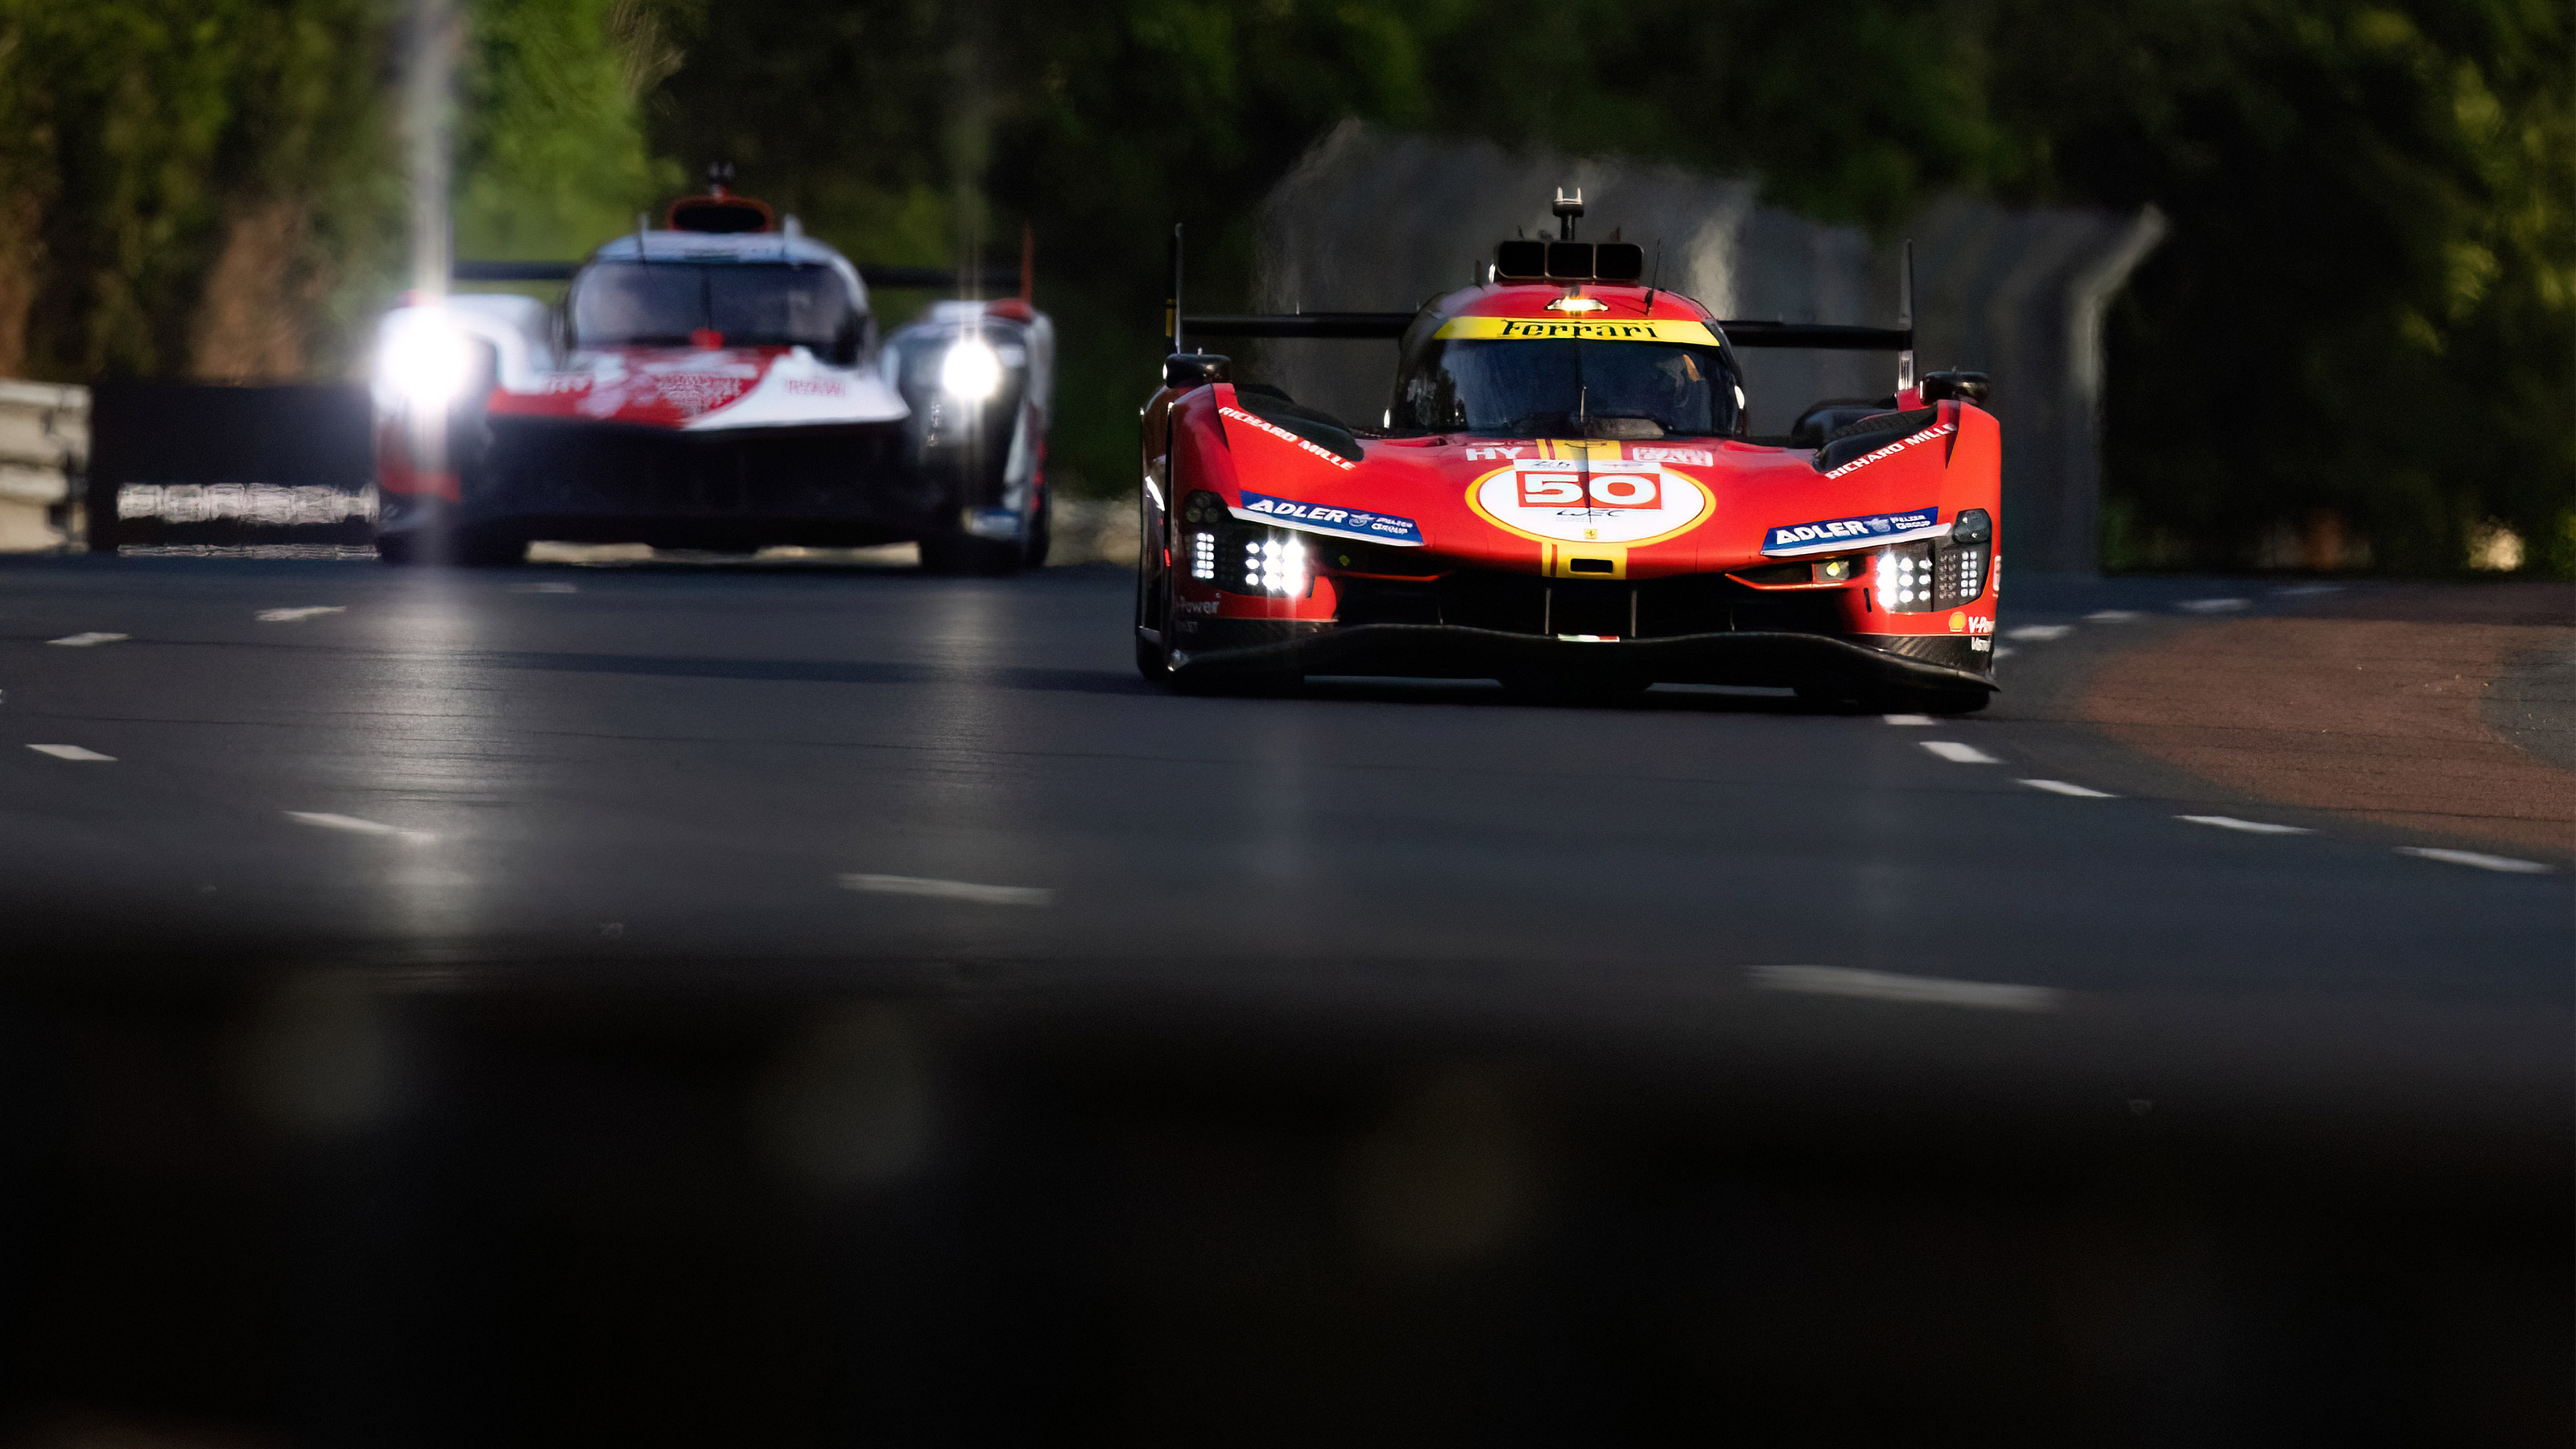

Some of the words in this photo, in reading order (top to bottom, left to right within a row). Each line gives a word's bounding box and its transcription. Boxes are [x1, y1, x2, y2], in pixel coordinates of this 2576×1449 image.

[1500, 320, 1658, 338] Ferrari
[1218, 407, 1298, 442] RICHARD
[1298, 440, 1356, 470] MILLE
[1466, 448, 1522, 460] HY
[1824, 443, 1905, 480] RICHARD
[1525, 473, 1656, 505] 50
[1247, 499, 1348, 523] ADLER
[1776, 521, 1869, 545] ADLER
